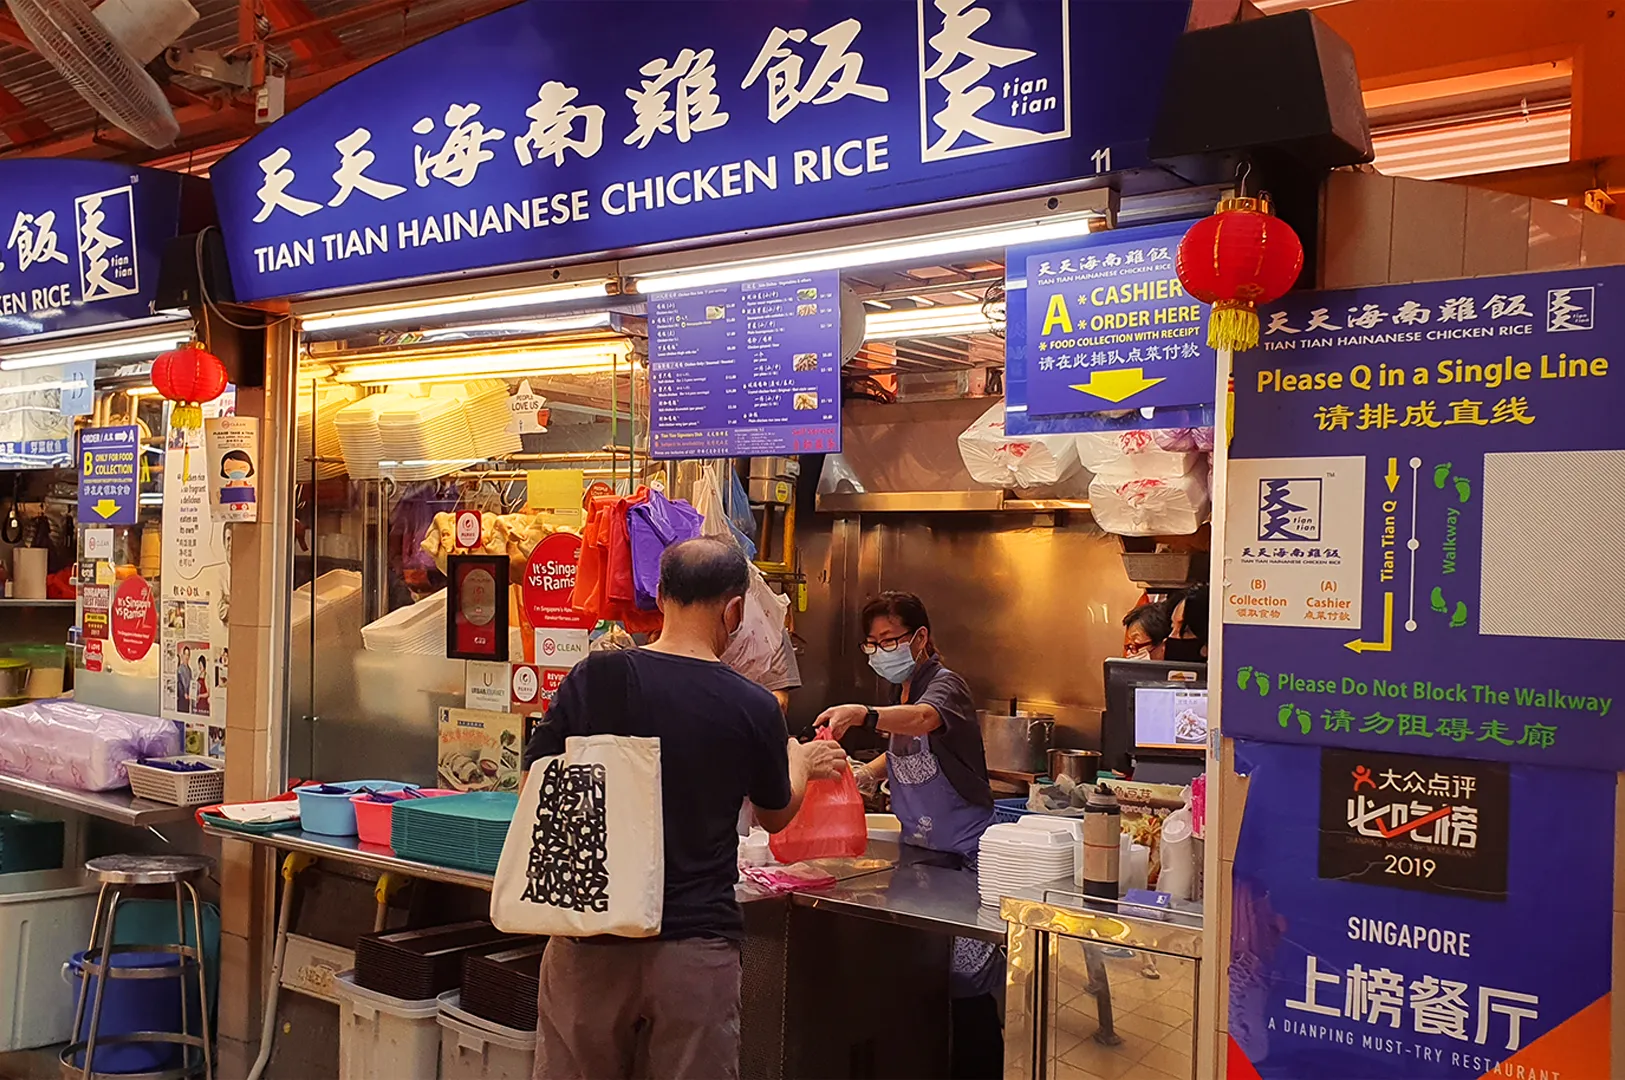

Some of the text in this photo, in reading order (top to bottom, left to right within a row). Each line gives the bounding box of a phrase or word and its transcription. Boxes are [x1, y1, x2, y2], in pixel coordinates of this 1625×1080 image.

[1002, 75, 1048, 99] tian
[1011, 93, 1057, 117] tian
[252, 18, 890, 223] 天天海南雞飯
[1090, 147, 1111, 175] 11
[254, 238, 315, 274] TIAN
[321, 223, 390, 263] TIAN
[398, 188, 590, 251] HAINANESE
[601, 158, 778, 216] CHICKEN
[793, 134, 890, 186] RICE
[0, 210, 69, 272] 飯
[111, 255, 129, 267] tian
[115, 267, 132, 278] tian
[1037, 246, 1173, 278] 天天海南雞飯
[1038, 262, 1172, 286] TIAN TIAN HAINANESE CHICKEN RICE
[31, 283, 71, 311] RICE
[1091, 278, 1184, 307] CASHIER
[1041, 292, 1073, 336] A
[1090, 305, 1201, 331] ORDER HERE
[1264, 293, 1534, 336] 天天海南雞飯
[1050, 326, 1200, 350] FOOD COLLECTION WITH RECEIPT
[1264, 323, 1533, 352] TIAN TIAN HAINANESE CHICKEN RICE
[1038, 341, 1201, 372] 请在此排队点菜付款
[1257, 352, 1609, 393] Please Q in a Single Line
[512, 401, 539, 411] LOVE US
[1314, 396, 1536, 432] 请排成直线
[127, 429, 134, 442] A
[83, 451, 93, 476] B
[95, 464, 133, 475] COLLECTION
[120, 452, 134, 461] FOOD
[1293, 516, 1313, 524] tian
[1296, 523, 1316, 531] tian
[1241, 547, 1341, 559] 天天海南雞飯
[1380, 500, 1398, 582] Tian Tian Q
[1442, 507, 1460, 574] Walkway
[532, 560, 576, 577] It's Singa
[528, 575, 576, 591] vs Rams
[1250, 579, 1266, 591] (B)
[1321, 580, 1337, 593] (A)
[1229, 594, 1287, 606] Collection
[1306, 597, 1351, 608] Cashier
[557, 643, 582, 652] CLEAN
[1278, 673, 1613, 717] Please Do Not Block The Walkway
[1320, 709, 1558, 750] 请勿阻碍走廊
[1378, 768, 1477, 800] 大众点评
[1347, 795, 1478, 849] 必吃榜
[1384, 854, 1437, 878] 2019
[1347, 915, 1471, 958] SINGAPORE
[1285, 955, 1538, 1052] 上榜餐厅
[1268, 1016, 1560, 1080] A DIANPING MUST-TRY RESTAURANT
